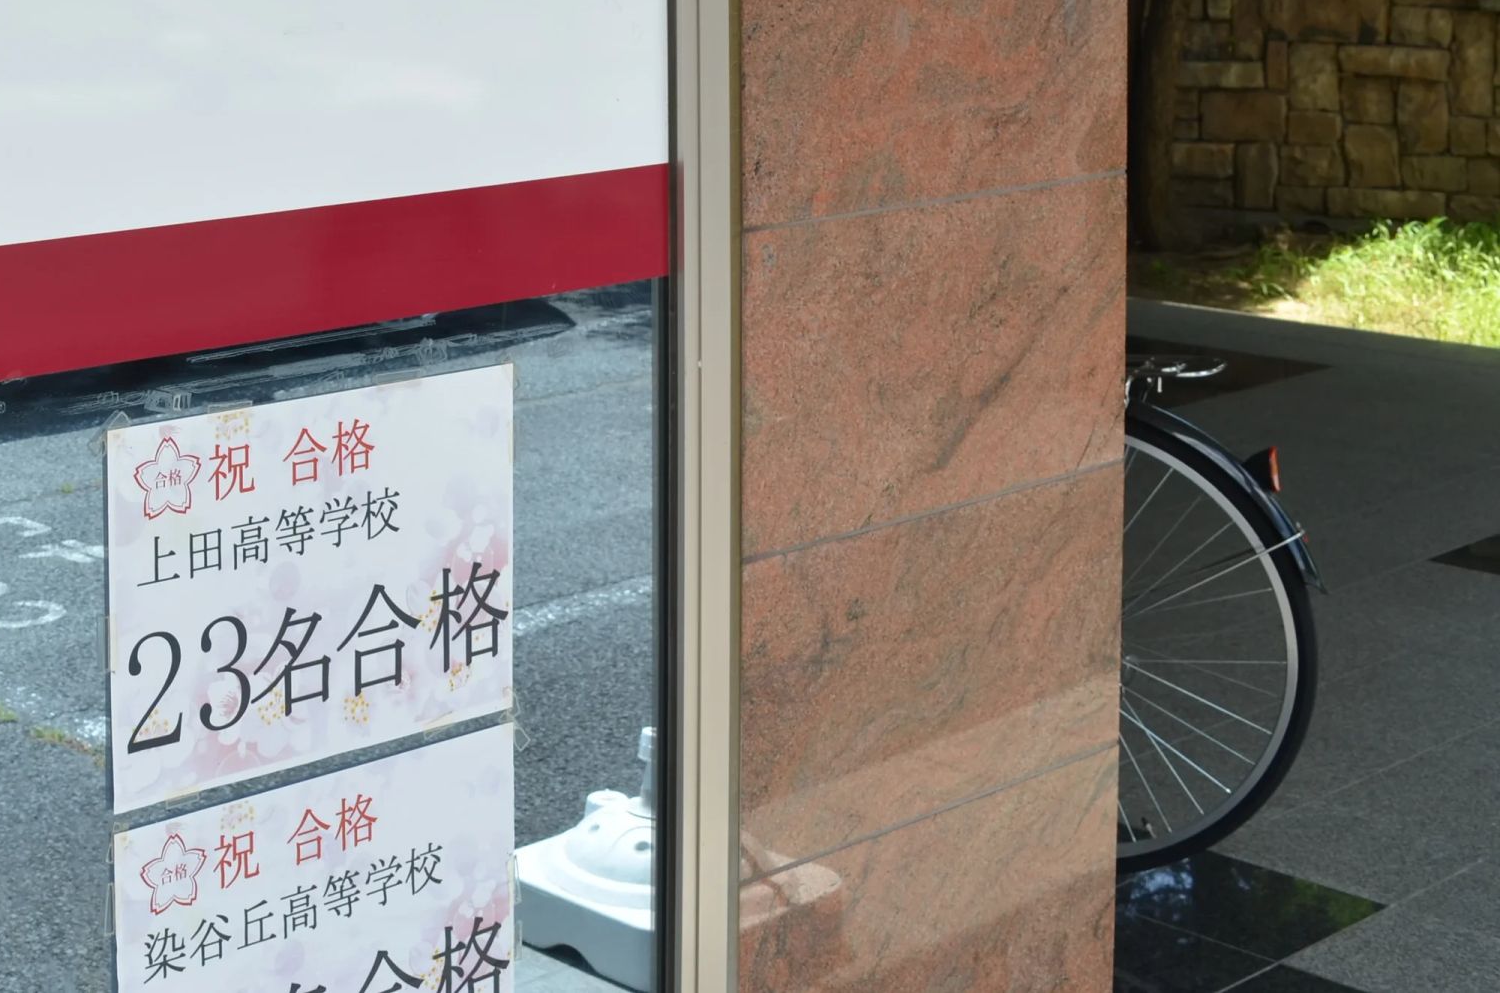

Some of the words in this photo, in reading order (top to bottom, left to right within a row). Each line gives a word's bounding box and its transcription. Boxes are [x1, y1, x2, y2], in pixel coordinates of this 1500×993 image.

[155, 468, 182, 489] 合格
[208, 443, 255, 501] 祝
[283, 418, 375, 486] 合格
[137, 487, 400, 588] 上田高等学校
[127, 561, 509, 755] 23名合格
[213, 830, 260, 889] 祝
[286, 793, 378, 866] 合格
[143, 842, 444, 984] 染谷丘高等学校
